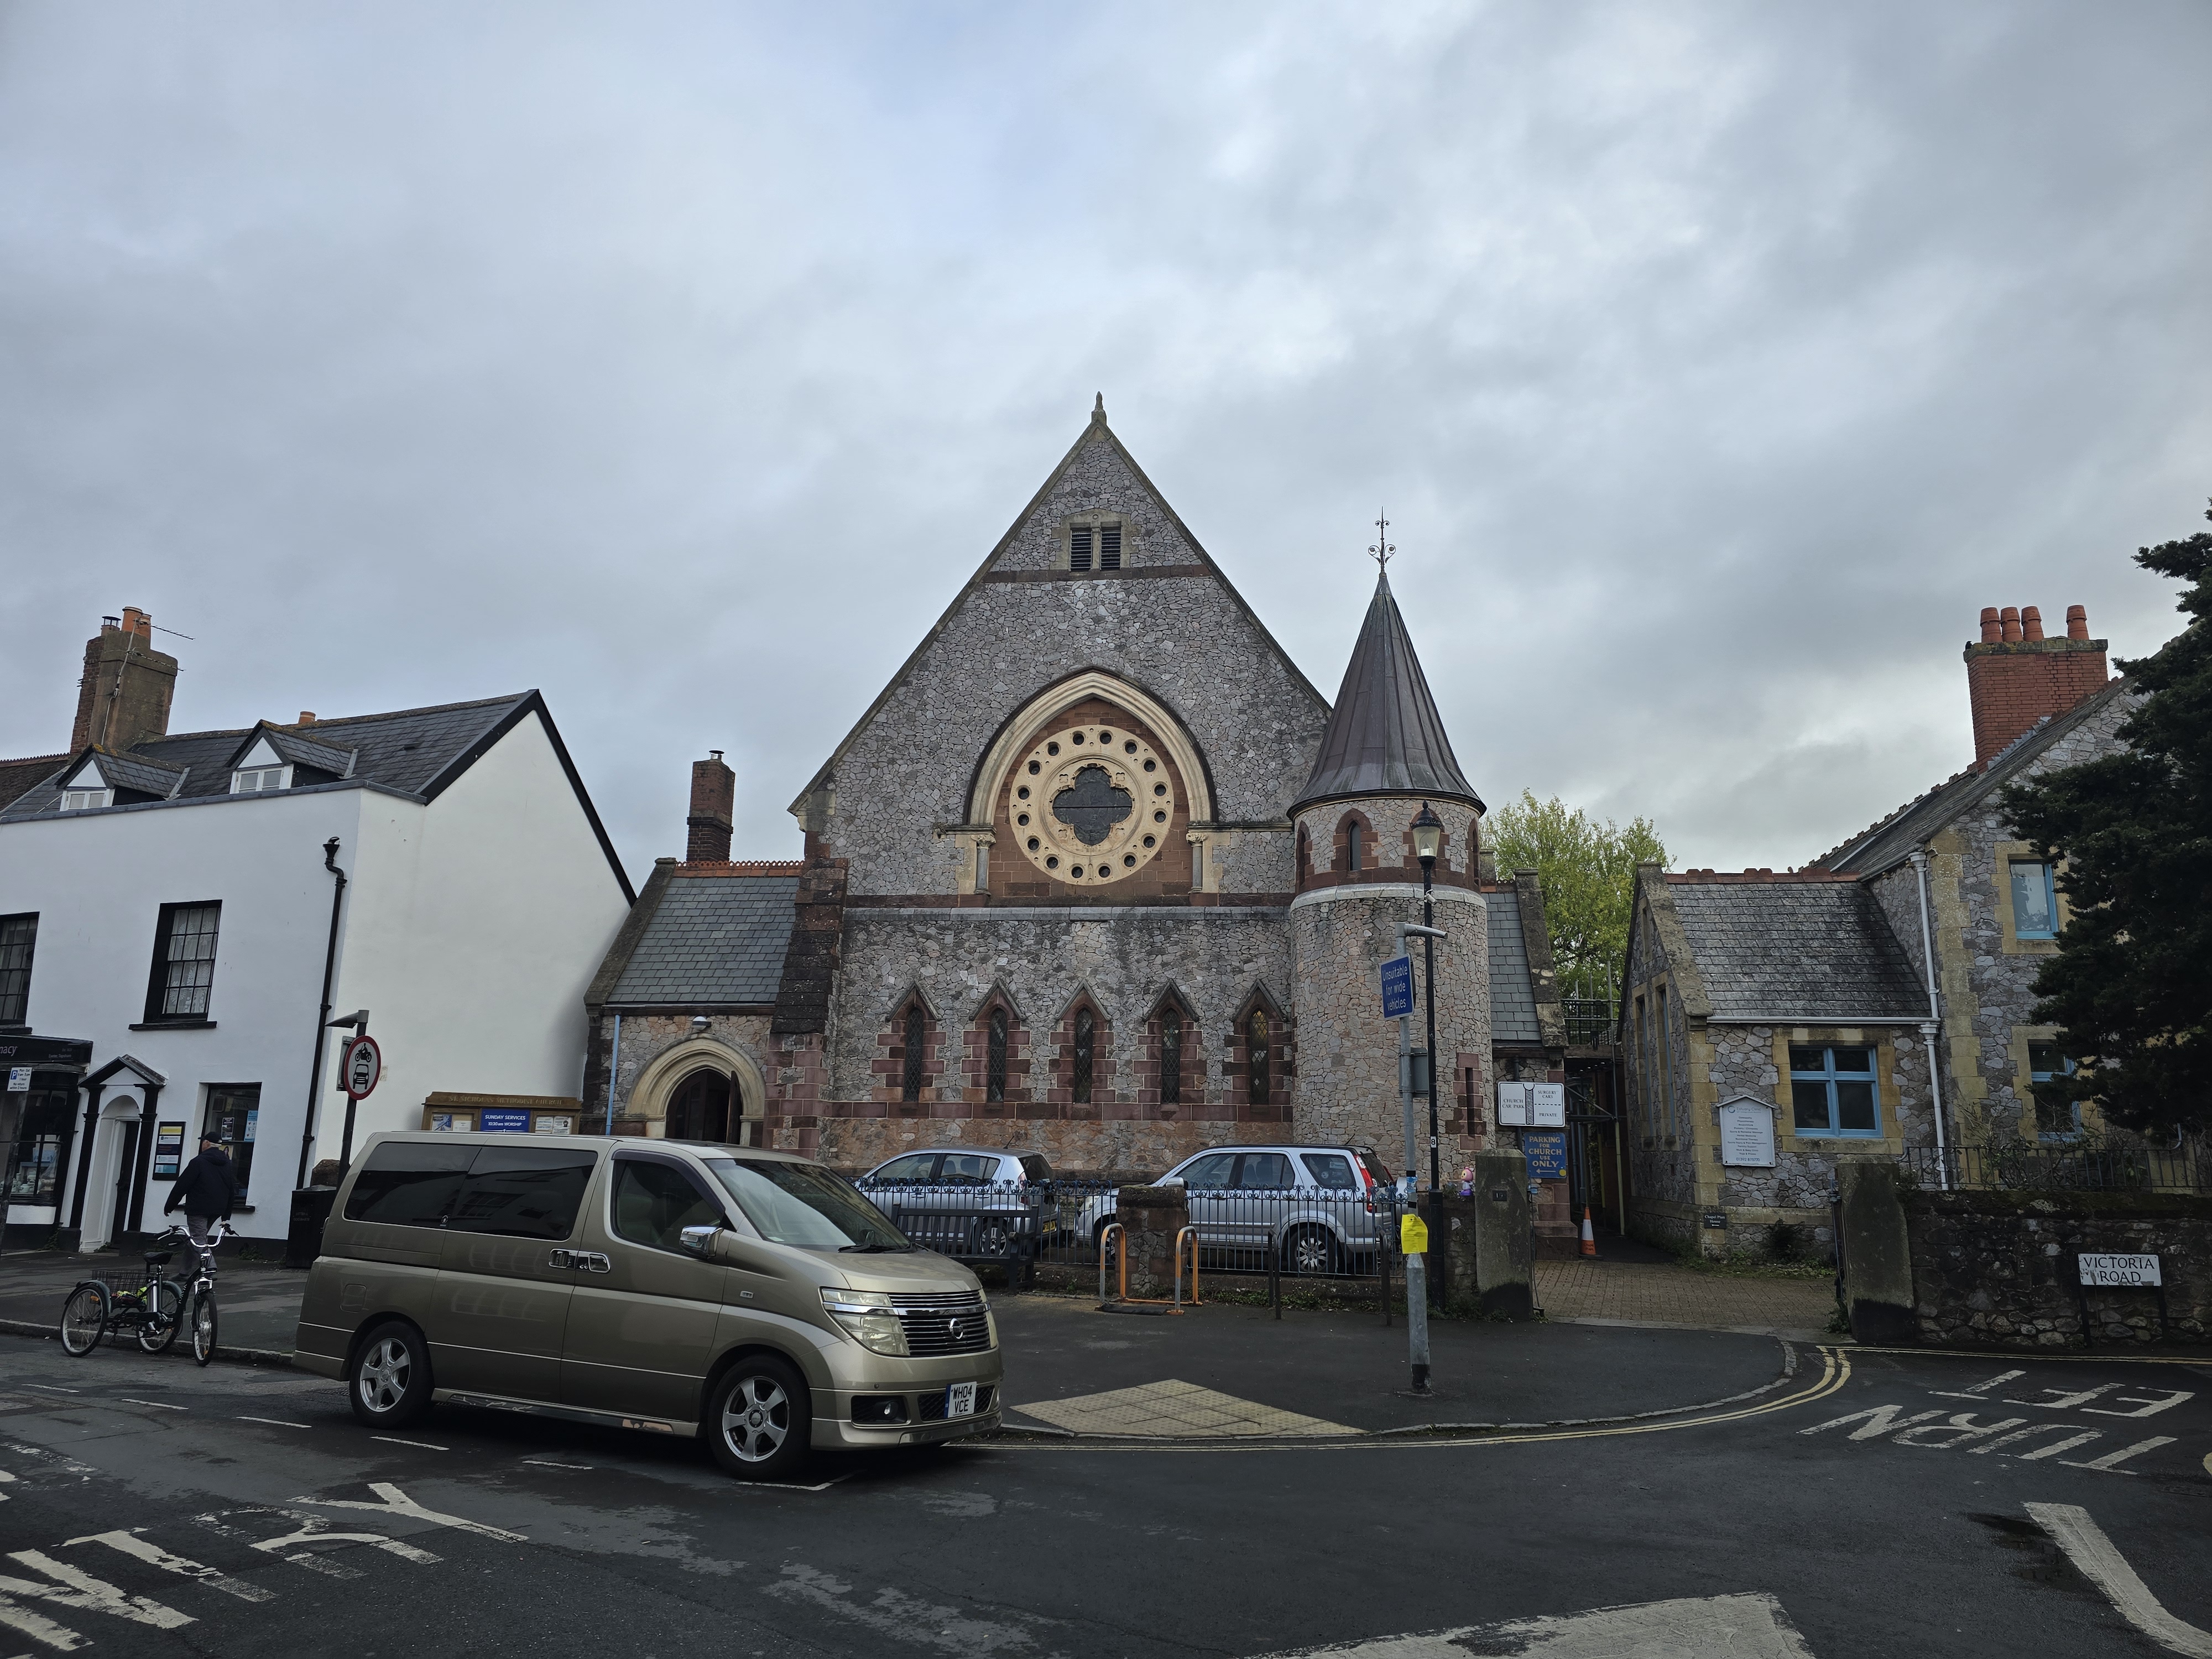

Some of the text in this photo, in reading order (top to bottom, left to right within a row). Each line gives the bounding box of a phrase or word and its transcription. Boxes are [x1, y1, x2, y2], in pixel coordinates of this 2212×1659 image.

[1383, 964, 1408, 982] Unsuitable
[1394, 980, 1406, 994] wide
[1387, 997, 1406, 1011] vehicles
[2084, 1257, 2154, 1269] VICTORIA
[2100, 1271, 2141, 1282] ROAD
[953, 1385, 972, 1400] WH04
[954, 1399, 969, 1413] VCE
[1796, 1405, 2178, 1475] TURN
[0, 1482, 529, 1659] NTRY
